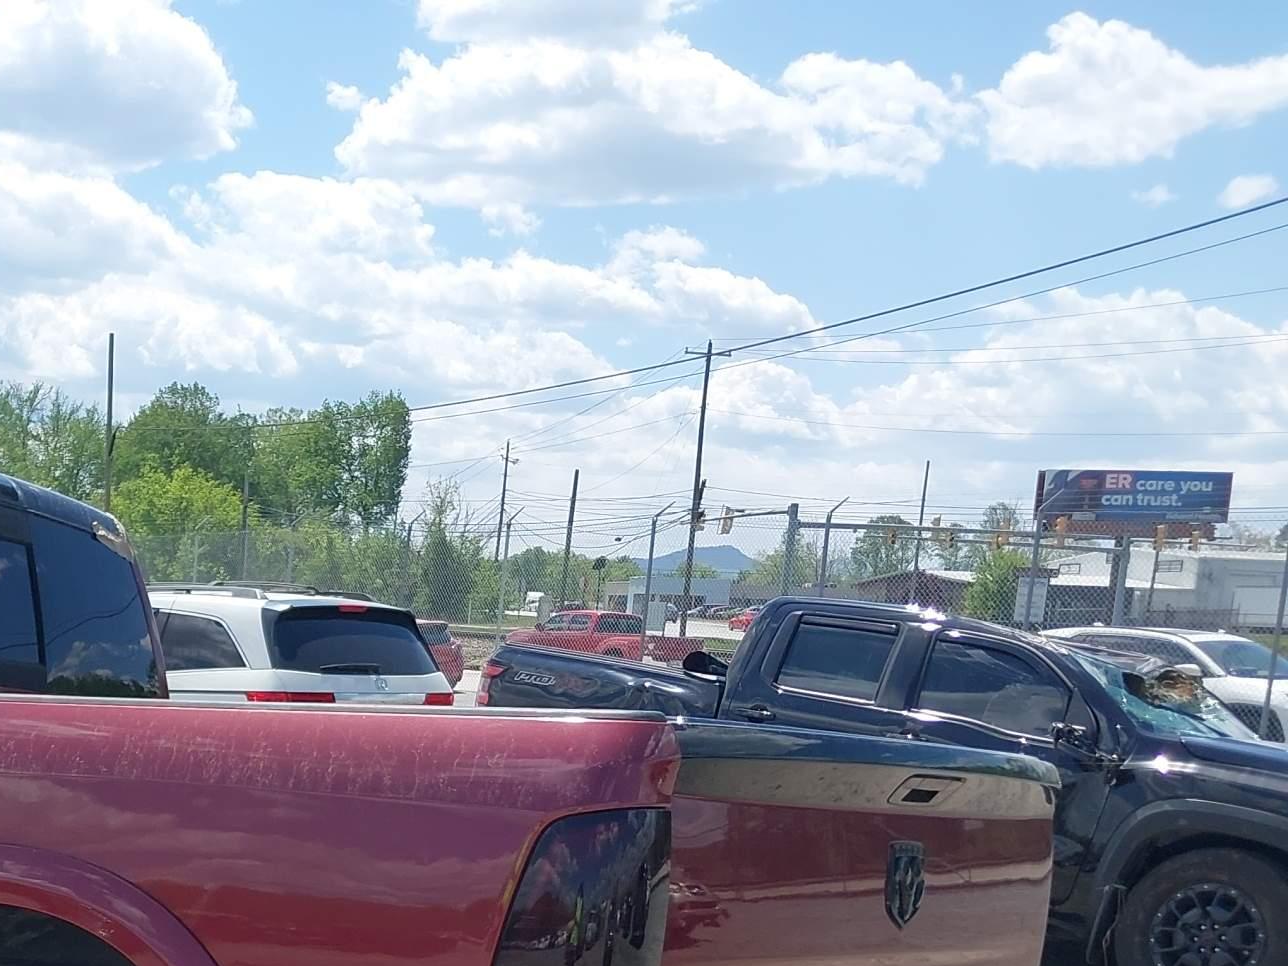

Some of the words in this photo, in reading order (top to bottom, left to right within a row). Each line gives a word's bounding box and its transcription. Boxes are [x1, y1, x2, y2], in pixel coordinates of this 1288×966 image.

[1105, 474, 1132, 489] ER
[1136, 480, 1176, 491] care
[1180, 480, 1213, 494] you
[1101, 494, 1132, 506] can
[1137, 494, 1182, 506] trust.
